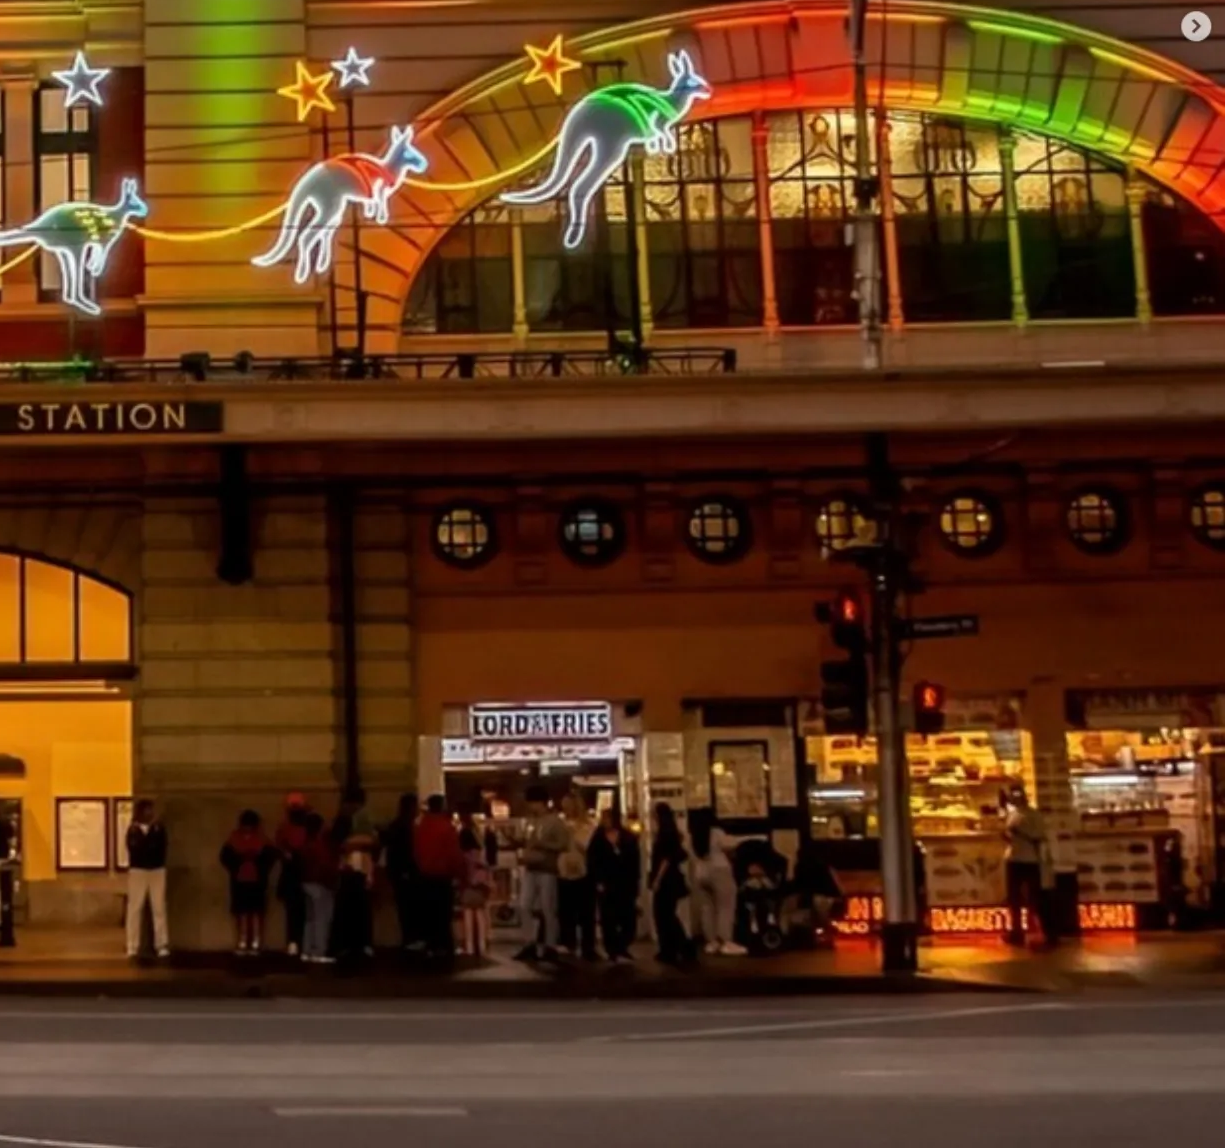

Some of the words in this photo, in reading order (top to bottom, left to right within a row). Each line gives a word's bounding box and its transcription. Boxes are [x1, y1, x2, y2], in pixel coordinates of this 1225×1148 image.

[17, 403, 186, 431] STATION
[473, 714, 529, 736] LORD
[551, 712, 609, 735] FRIES
